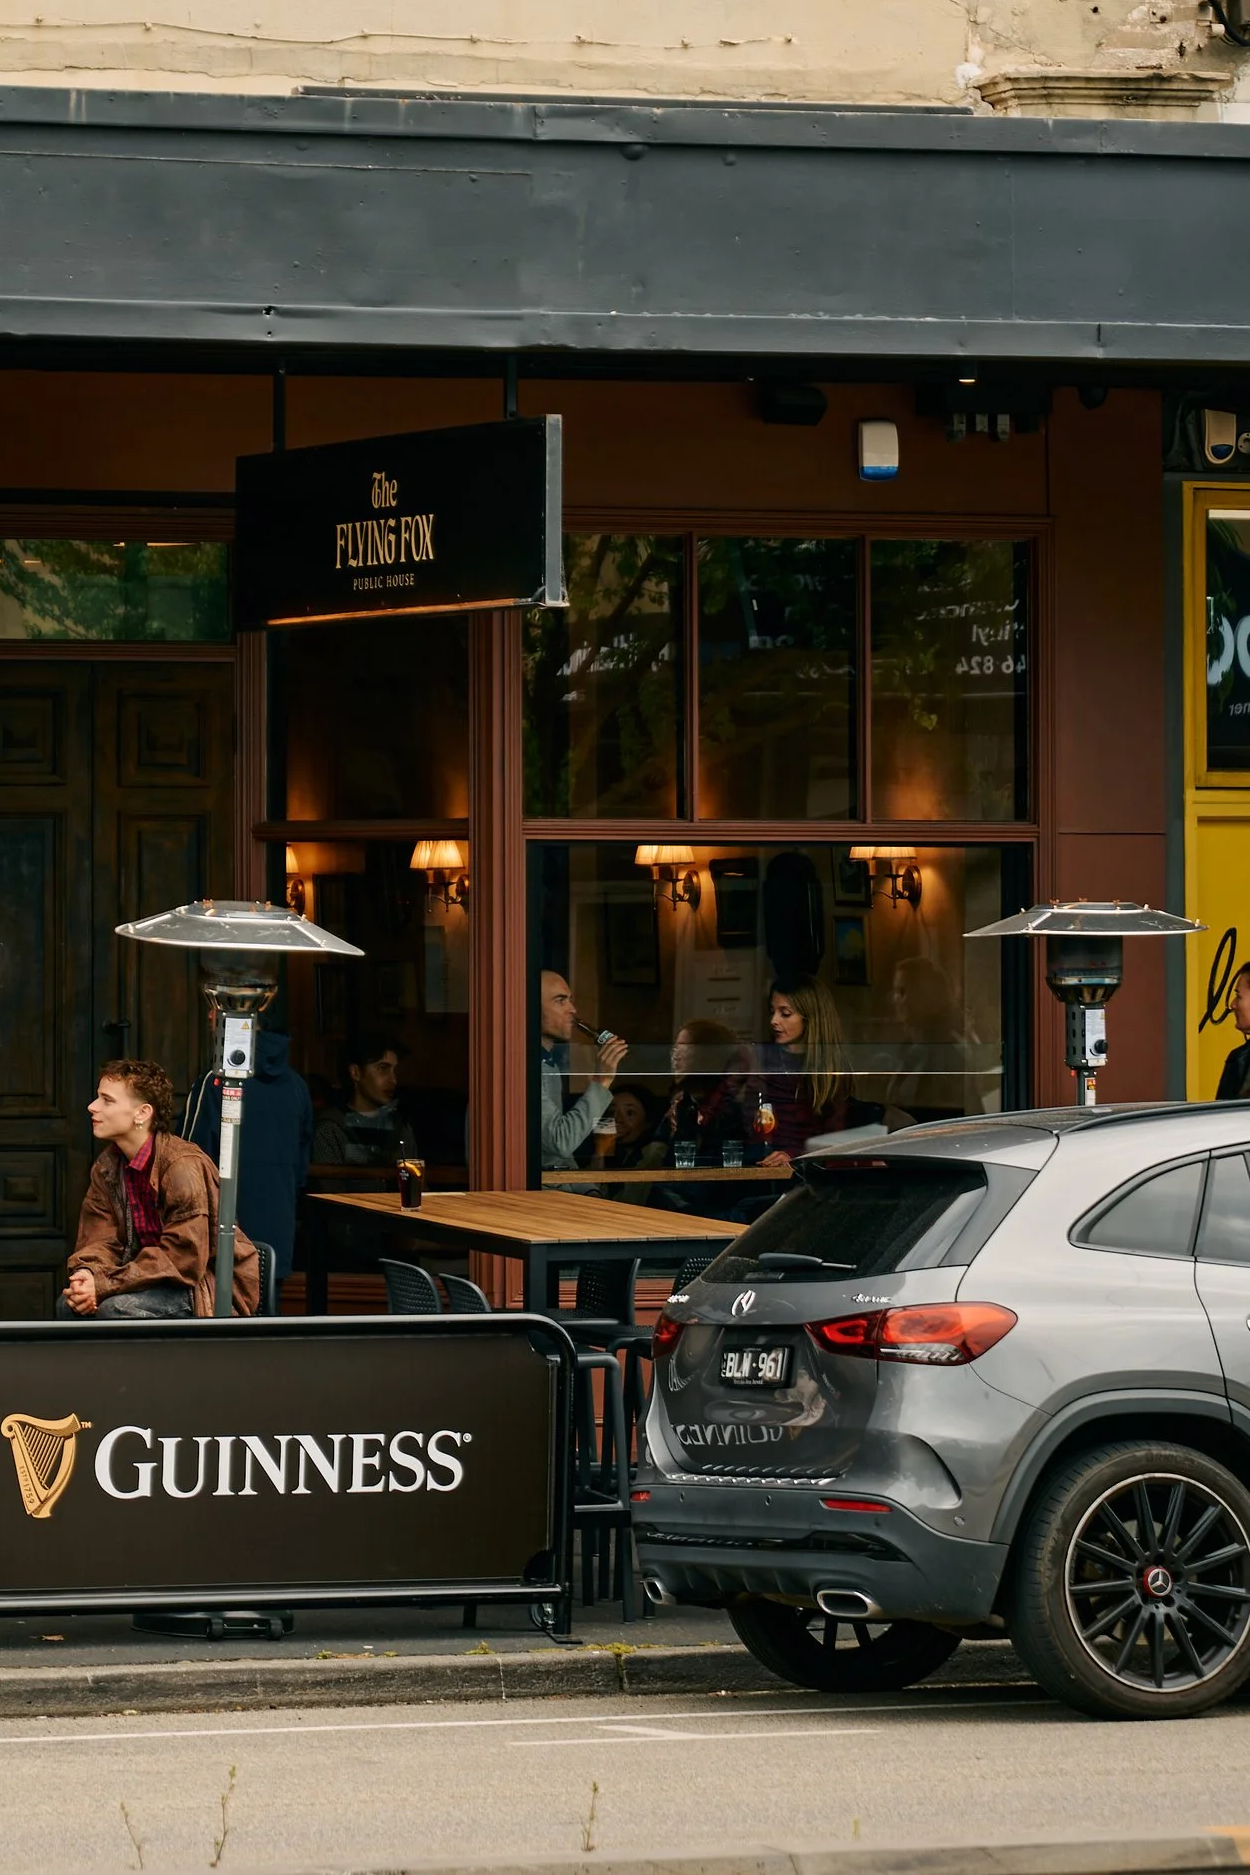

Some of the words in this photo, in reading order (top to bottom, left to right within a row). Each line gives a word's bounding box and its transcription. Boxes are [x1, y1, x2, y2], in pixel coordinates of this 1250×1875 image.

[371, 471, 398, 509] The
[335, 517, 396, 569] FLYING
[399, 513, 434, 563] FOX
[353, 577, 383, 590] PUBLIC
[387, 573, 415, 588] HOUSE
[94, 1425, 465, 1500] GUINNESS
